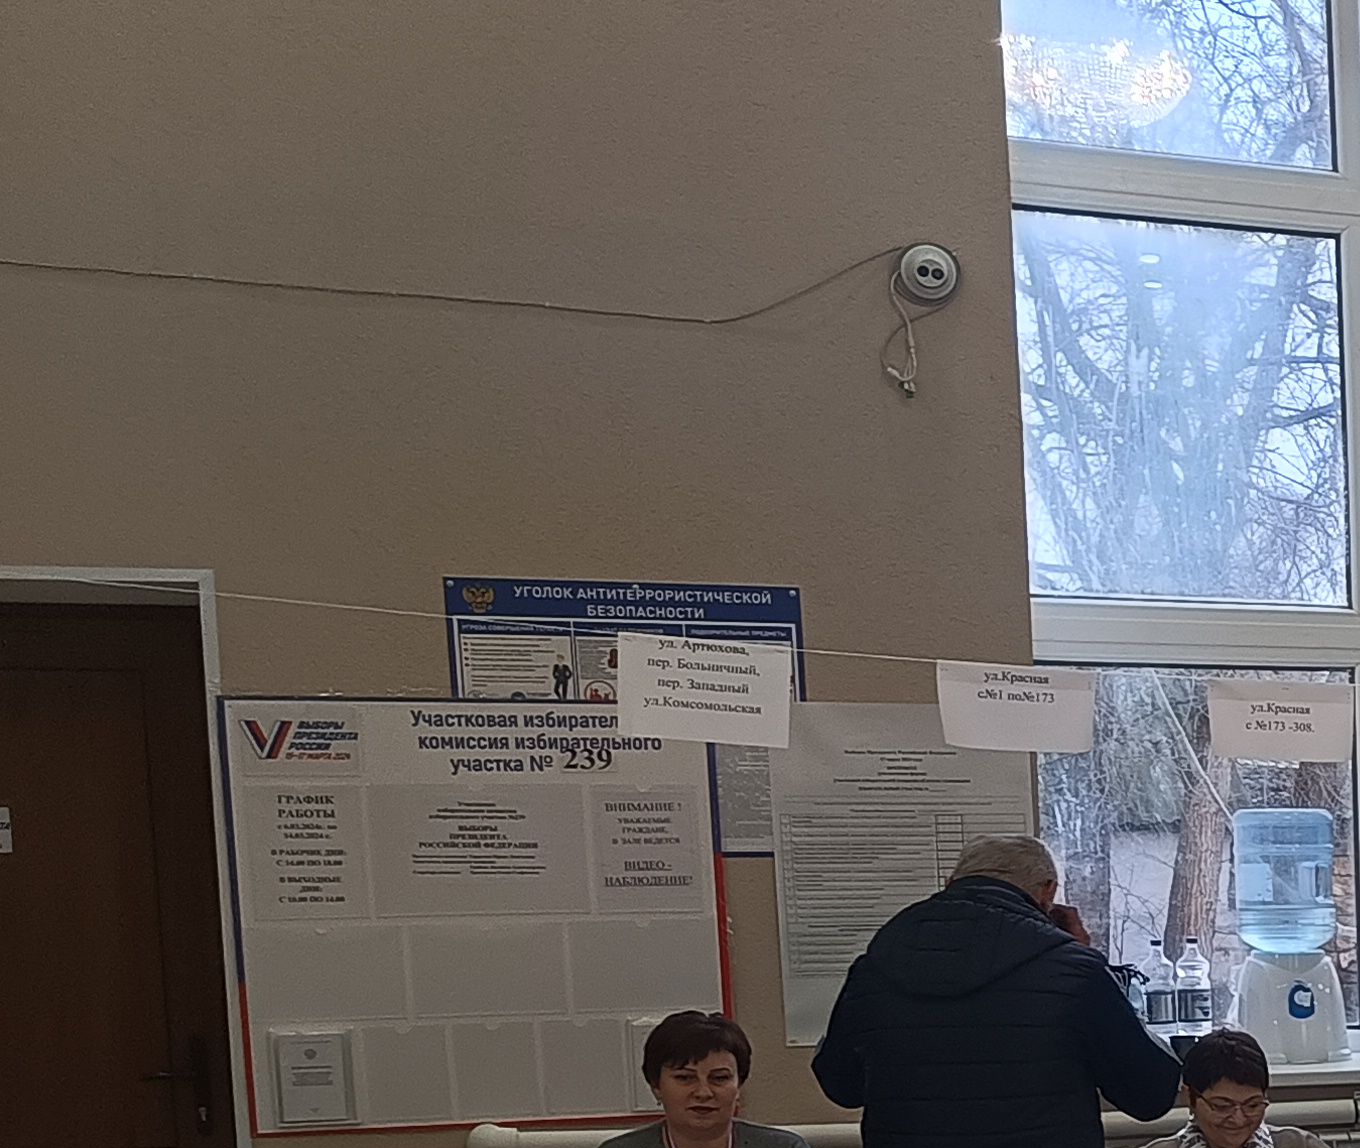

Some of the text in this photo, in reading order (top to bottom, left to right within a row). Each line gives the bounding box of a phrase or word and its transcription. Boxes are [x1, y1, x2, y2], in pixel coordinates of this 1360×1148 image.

[514, 586, 772, 605] УГОЛОК АНТИТЕРРОРИСТИЧЕСКОЙ
[586, 604, 704, 619] БЕЗОПАСНОСТИ
[659, 639, 750, 656] ул. Артюхова,
[647, 658, 672, 670] пер.
[984, 671, 1050, 685] ул.Красная
[657, 678, 749, 694] пер. Западный
[644, 696, 762, 715] ул.Комсомольская
[1250, 702, 1311, 715] ул.Красная
[410, 709, 618, 732] Участковая избирател
[1246, 722, 1252, 730] с
[1254, 720, 1286, 731] №173
[418, 734, 662, 755] комиссия избирательного
[450, 750, 612, 775] участка № 239
[277, 794, 335, 804] ГРАФИК
[277, 809, 336, 818] РАБОТЫ
[605, 802, 674, 812] ВНИМАНИЕ
